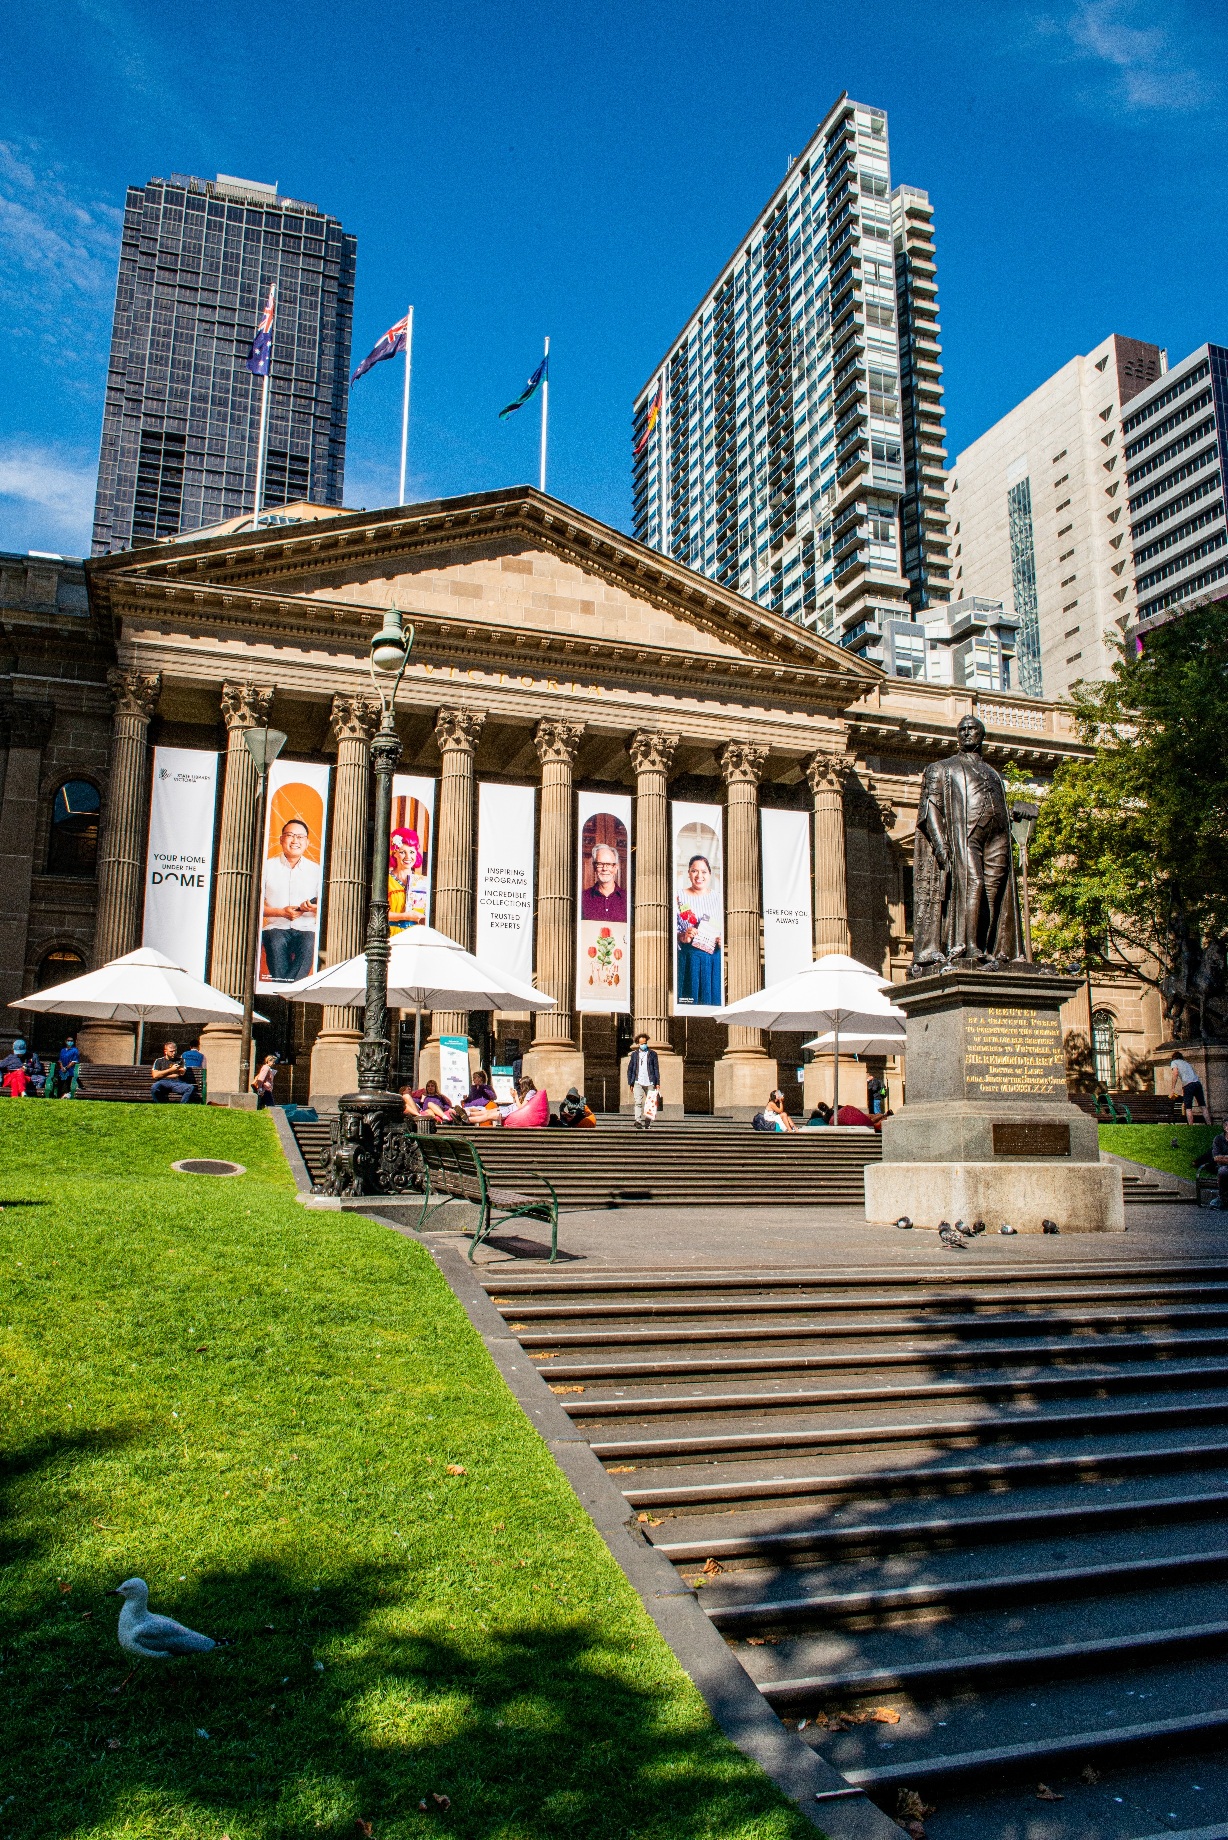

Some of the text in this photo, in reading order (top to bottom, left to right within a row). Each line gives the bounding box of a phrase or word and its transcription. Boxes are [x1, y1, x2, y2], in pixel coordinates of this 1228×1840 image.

[421, 660, 602, 696] VICTORIA
[154, 854, 206, 864] YOUR HOME
[487, 868, 525, 876] INSPIRING
[151, 871, 205, 888] DOME
[484, 876, 528, 885] PROGRAMS
[484, 890, 526, 898] INCREDIBLE
[480, 898, 530, 907] COLLECTIONS
[490, 912, 520, 920] TRUSTED
[490, 922, 520, 930] EXPERTS
[988, 1007, 1036, 1017] ERECTED
[401, 1023, 407, 1032] 1
